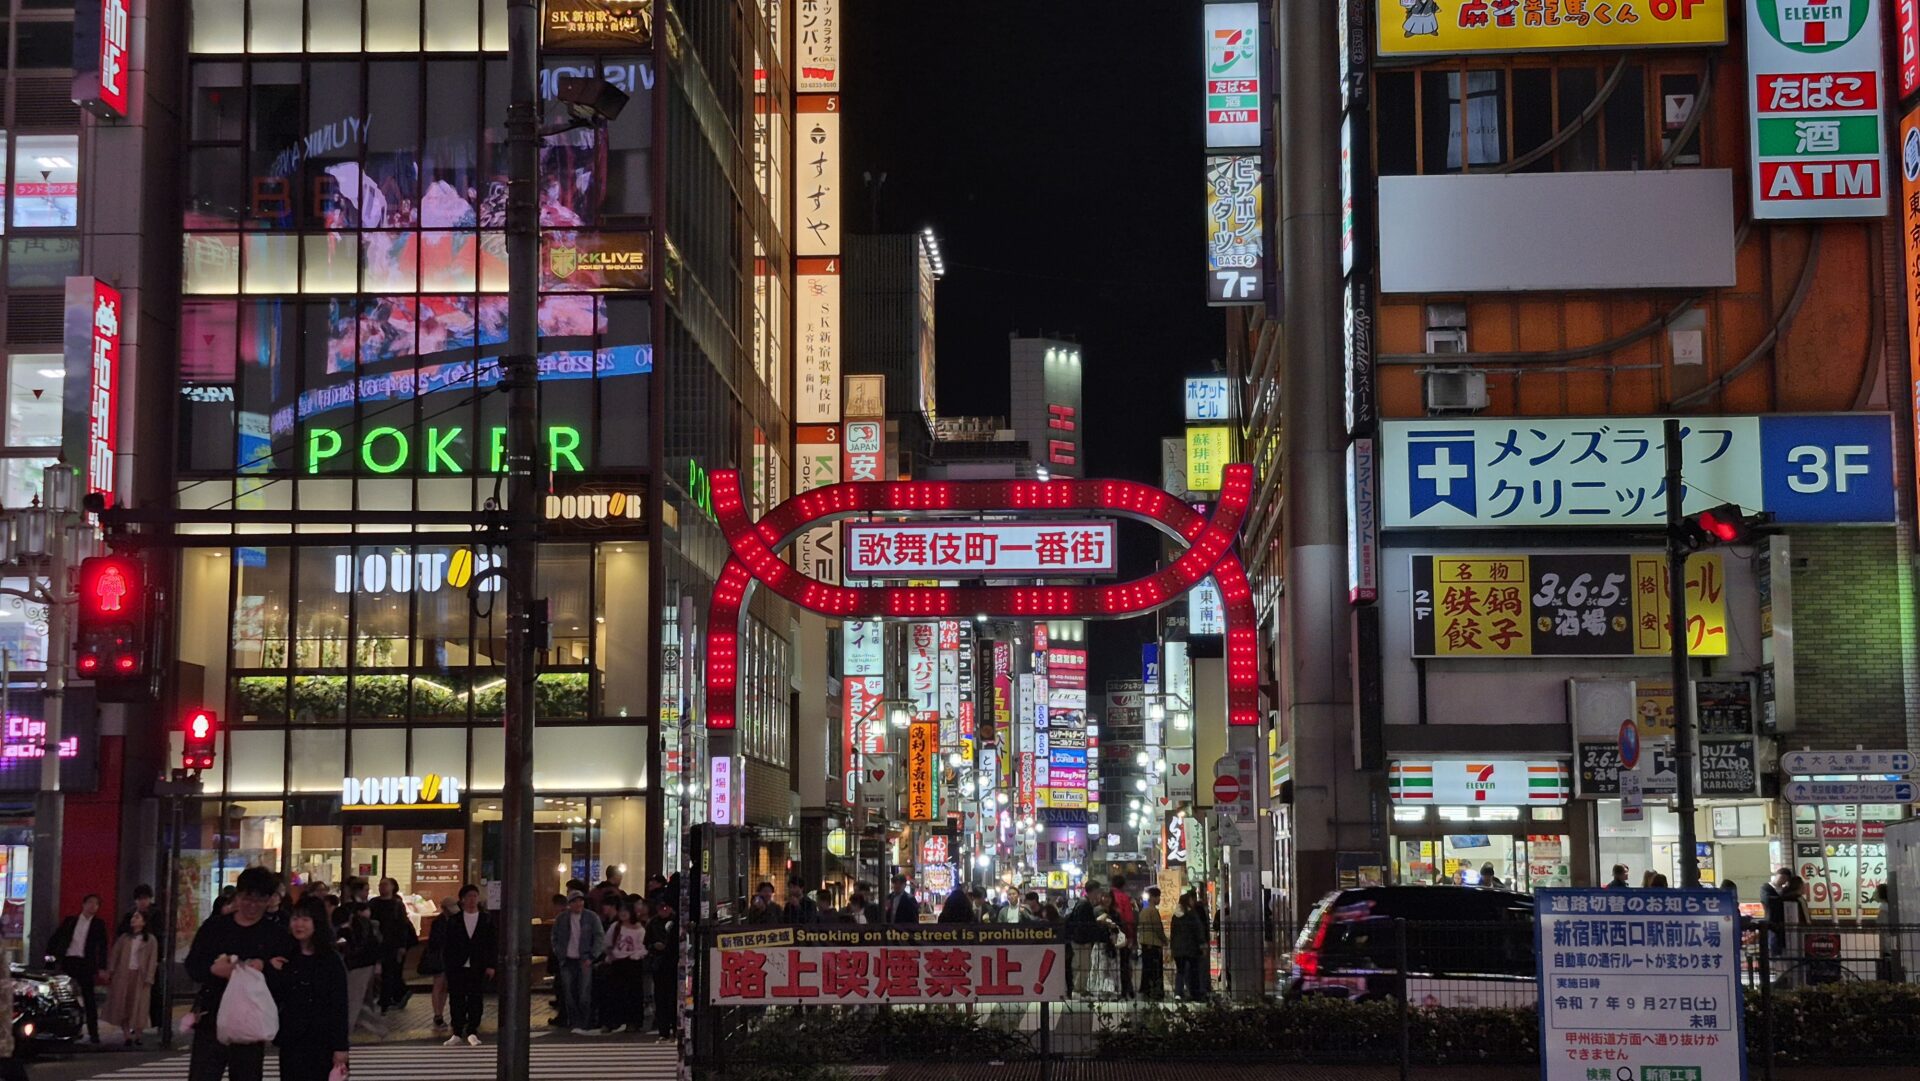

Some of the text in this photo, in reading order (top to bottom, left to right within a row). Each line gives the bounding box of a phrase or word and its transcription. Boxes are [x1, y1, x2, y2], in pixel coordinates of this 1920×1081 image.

[1785, 5, 1843, 21] ELEVEN
[823, 18, 832, 53] カラオケ
[1215, 81, 1251, 93] たばこ
[1769, 75, 1865, 109] たばこ
[826, 97, 836, 111] 5
[1218, 111, 1249, 122] ATM
[1795, 120, 1840, 154] 酒
[1767, 164, 1873, 197] ATM
[807, 151, 830, 246] すずや
[825, 261, 835, 273] 4
[1216, 271, 1257, 298] 7F
[1187, 381, 1226, 398] ポケット
[1197, 402, 1218, 418] ビル
[826, 428, 836, 441] 3
[849, 442, 878, 451] JAPAN
[850, 454, 877, 481] 安
[1787, 445, 1869, 494] 3F
[546, 492, 641, 519] DOUTOR
[857, 531, 1104, 567] 歌舞伎町一番街
[1441, 586, 1523, 617] 鉄鍋
[1640, 576, 1657, 631] 格安
[1554, 607, 1607, 637] 酒場
[1442, 618, 1523, 650] 餃子
[1664, 614, 1724, 651] ワー
[856, 665, 871, 673] 3F
[869, 681, 881, 689] 2F
[916, 712, 931, 720] 4F
[1702, 745, 1737, 757] BUZZ
[1702, 757, 1750, 770] STAND
[1811, 755, 1888, 765] 大久保病院
[343, 774, 459, 805] DOUTOR
[715, 762, 727, 819] 劇場通り
[1049, 809, 1086, 822] SAUNA
[1530, 865, 1553, 876] たばこ
[1551, 896, 1720, 913] 道路切替のお知らせ
[720, 931, 791, 948] 新宿区内全域
[797, 928, 1057, 944] Smoking on the street is prohibited.
[1554, 920, 1721, 948] 新宿駅西口駅前広場
[1554, 952, 1723, 970] 自動車の通行ルートが変わります
[1556, 978, 1600, 989] 実施日時
[1689, 1014, 1717, 1028] 未明
[1565, 1032, 1719, 1047] 甲州街道方面へ通り抜けが
[1566, 1048, 1629, 1060] できません
[1586, 1068, 1612, 1081] 検索
